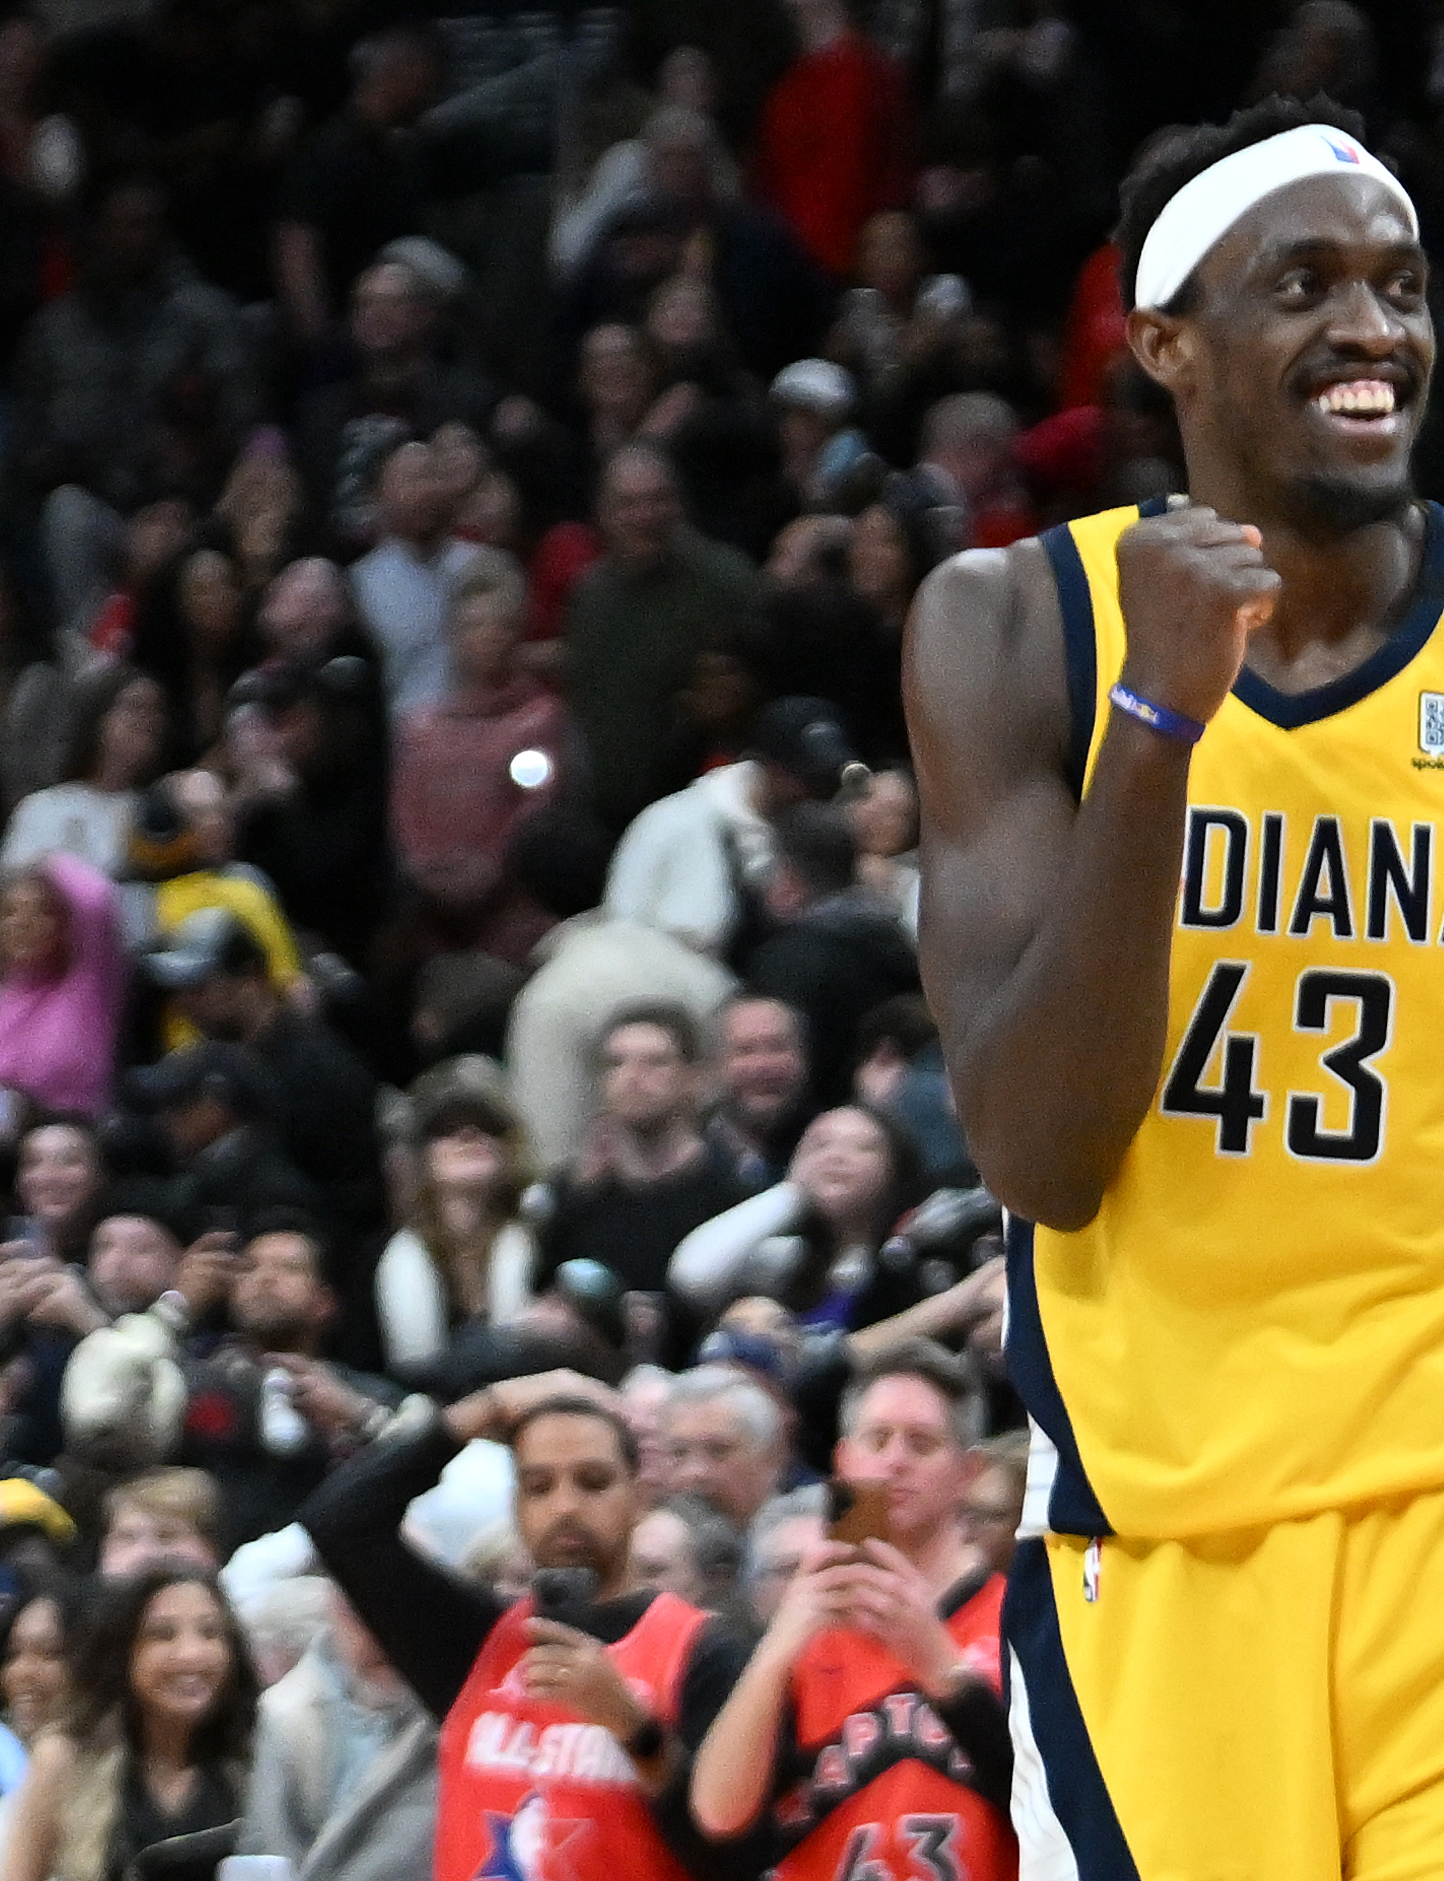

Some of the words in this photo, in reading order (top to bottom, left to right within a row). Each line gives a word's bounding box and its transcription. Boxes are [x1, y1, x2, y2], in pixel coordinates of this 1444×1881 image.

[1160, 959, 1397, 1166] 43
[465, 1711, 638, 1782] ALL-STA
[775, 1692, 975, 1828] RAPTO
